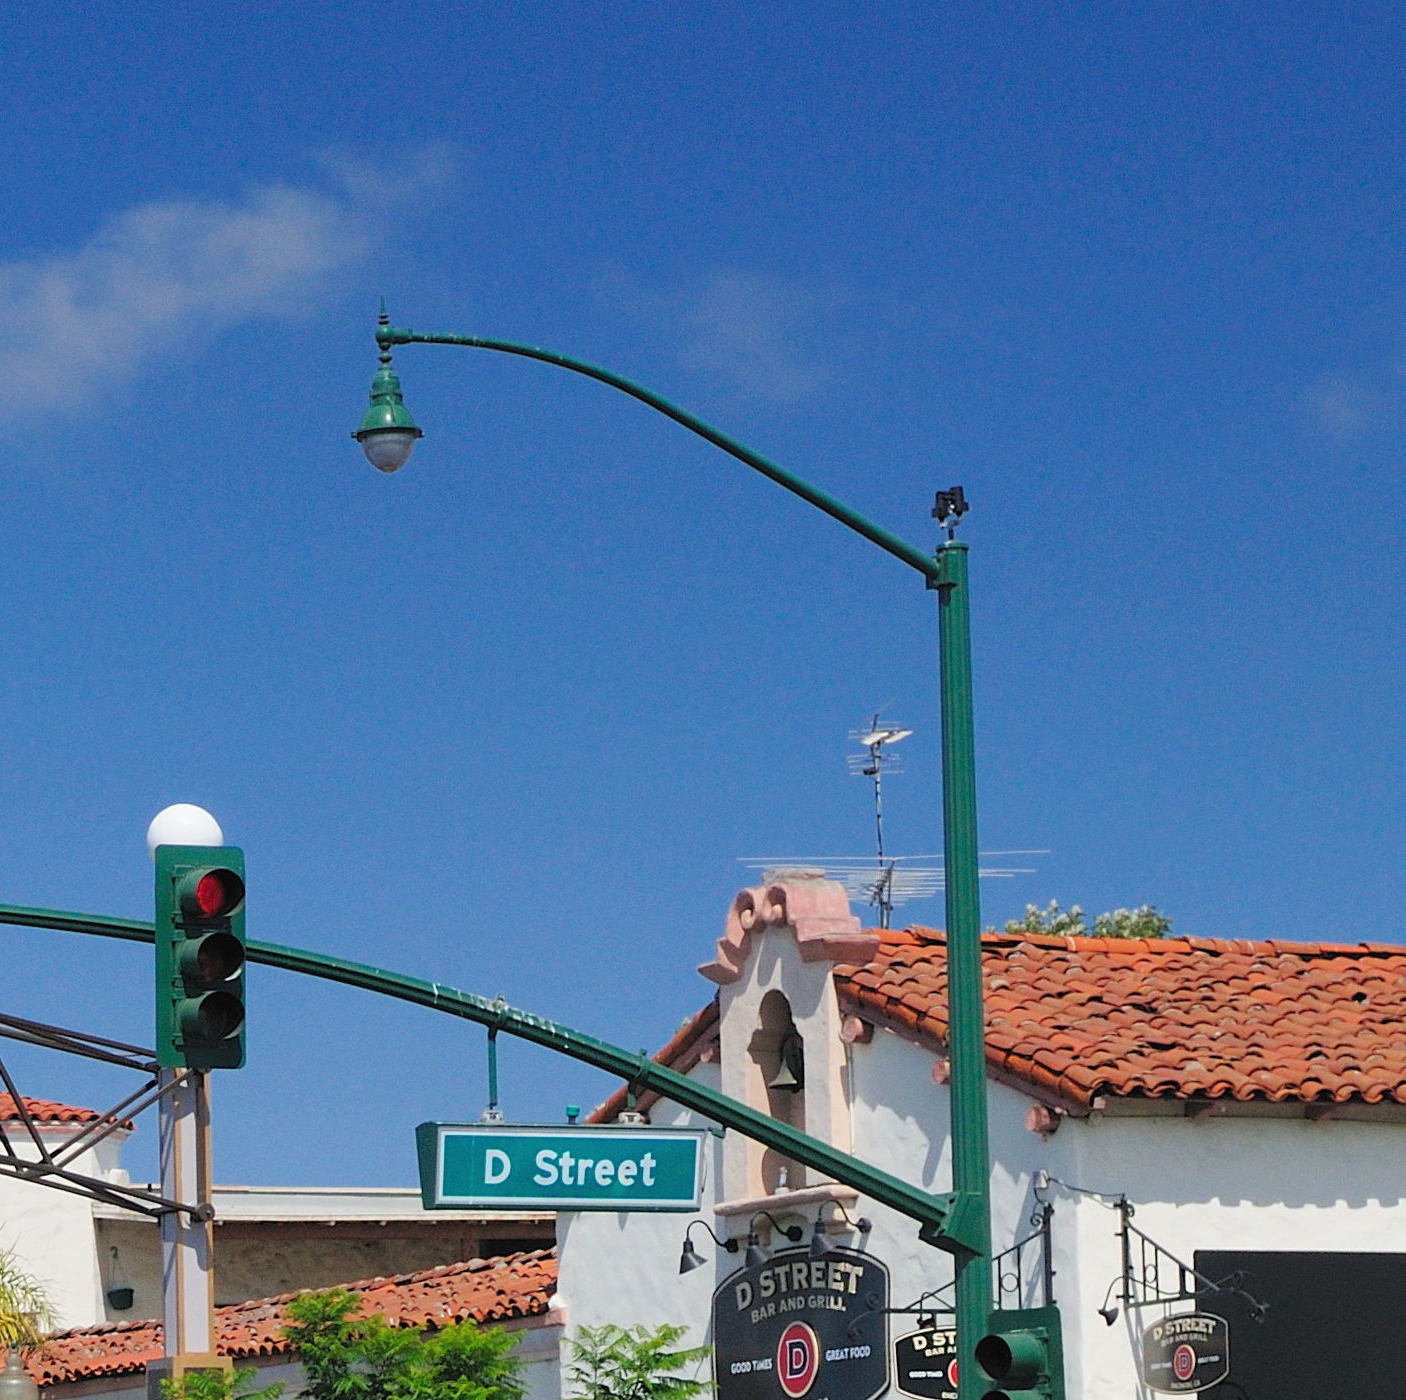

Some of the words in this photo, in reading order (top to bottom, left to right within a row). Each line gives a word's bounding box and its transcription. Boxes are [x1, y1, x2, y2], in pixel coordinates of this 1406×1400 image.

[484, 1149, 512, 1184] D
[533, 1149, 657, 1187] Street
[736, 1281, 753, 1311] D
[759, 1261, 864, 1298] STREET
[751, 1302, 777, 1324] BAR
[779, 1297, 806, 1314] AND
[808, 1295, 847, 1312] GRILL
[1165, 1318, 1217, 1335] STREET
[912, 1335, 927, 1351] D
[925, 1346, 945, 1357] BAR
[786, 1338, 809, 1379] D
[826, 1348, 848, 1362] GREAT
[849, 1346, 871, 1359] FOOD
[731, 1361, 752, 1375] GOOD
[752, 1358, 773, 1371] TIMES
